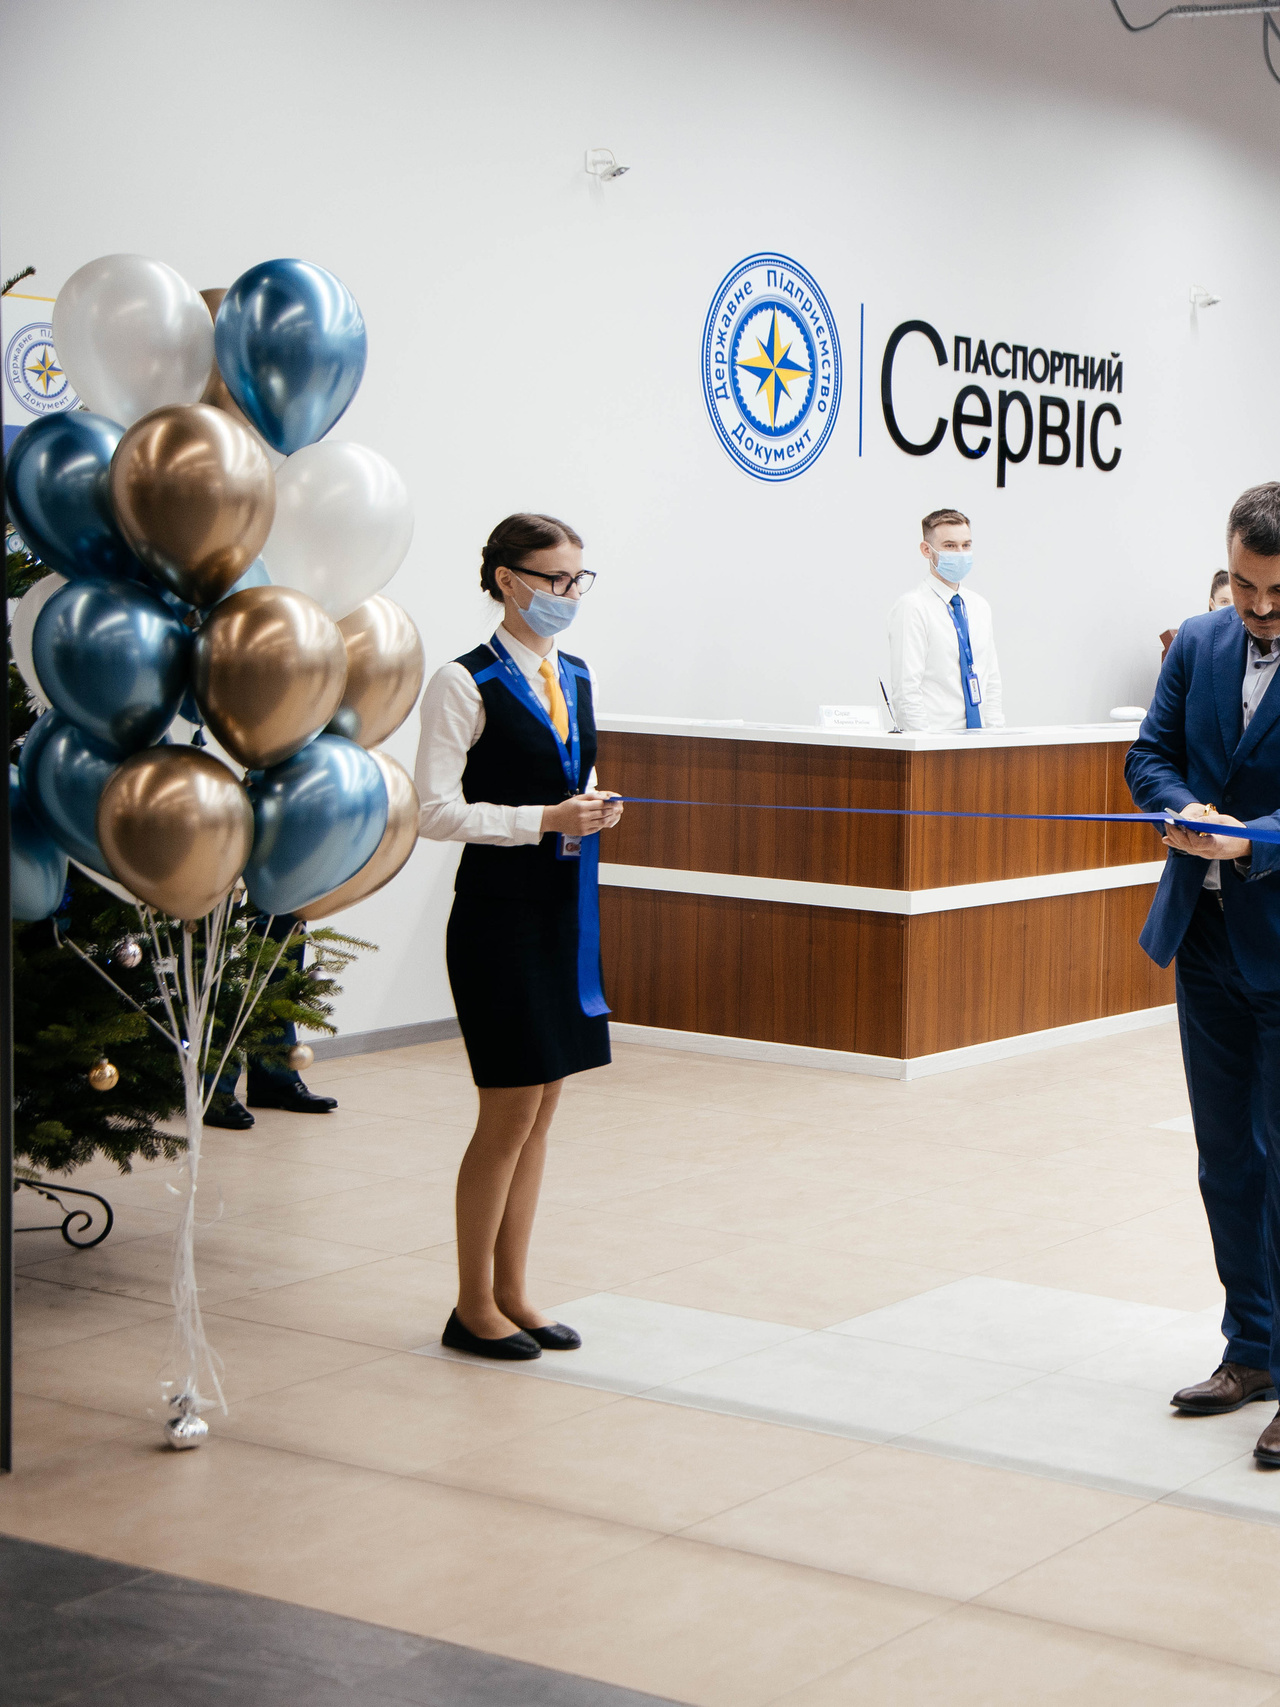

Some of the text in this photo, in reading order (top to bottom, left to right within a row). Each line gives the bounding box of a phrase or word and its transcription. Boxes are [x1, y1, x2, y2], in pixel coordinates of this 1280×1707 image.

[12, 333, 33, 384] Державне
[714, 269, 831, 413] Державне Підприємство
[953, 334, 1123, 394] ПАСПОРТНИЙ
[23, 391, 69, 410] Документ
[731, 421, 812, 465] Документ
